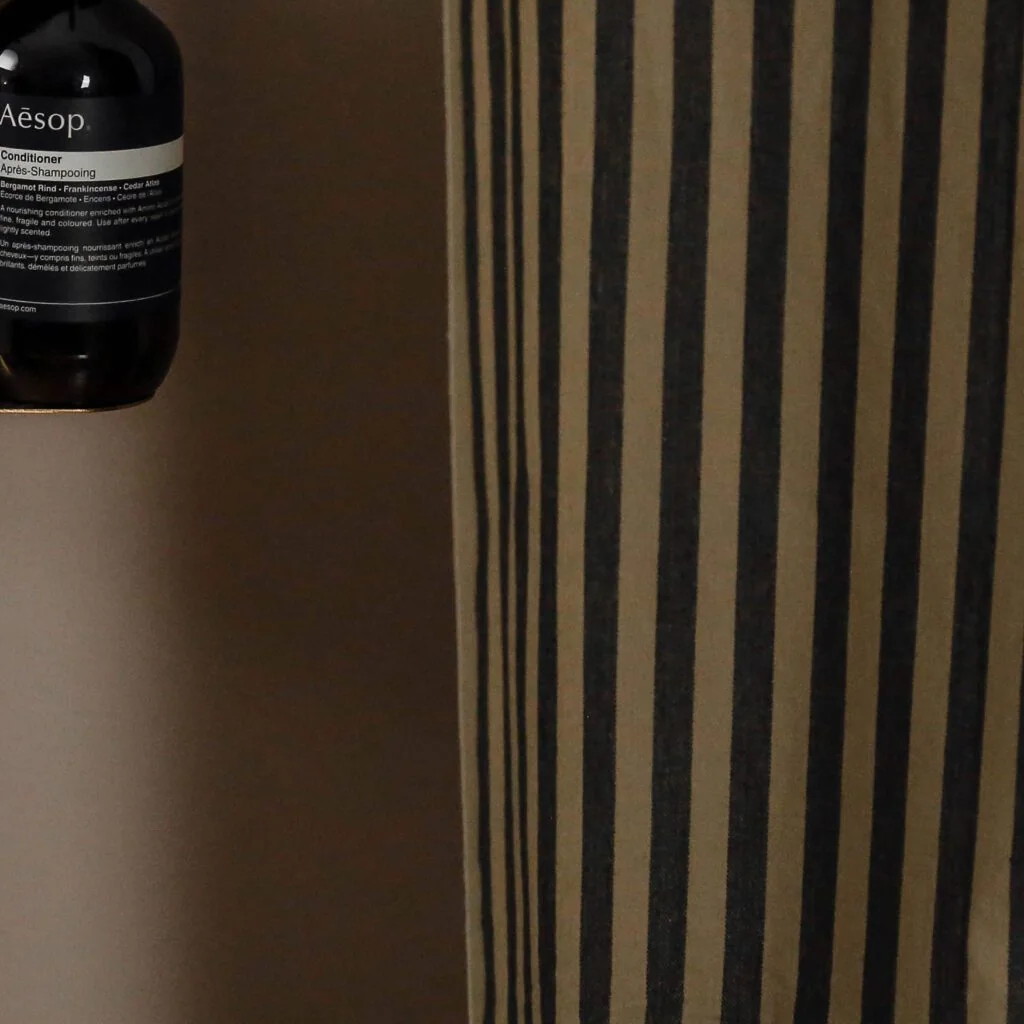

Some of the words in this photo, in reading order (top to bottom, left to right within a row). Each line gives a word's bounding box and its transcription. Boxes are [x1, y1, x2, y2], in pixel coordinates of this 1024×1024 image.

[0, 150, 62, 164] Conditioner
[0, 163, 96, 179] Après-Shampooing
[0, 180, 36, 192] Bergamot
[38, 184, 57, 193] Rind
[64, 184, 117, 193] Frankincense
[123, 182, 144, 191] Cedar
[145, 179, 160, 188] Atlas
[24, 194, 34, 202] de
[36, 194, 77, 204] Bergamote
[83, 195, 111, 203] Encens
[0, 204, 5, 212] A
[6, 206, 43, 217] nourishing
[45, 209, 88, 217] conditioner
[90, 208, 121, 217] enriched
[41, 219, 56, 227] and
[96, 219, 112, 227] Use
[0, 239, 9, 248] Un
[60, 264, 68, 272] et
